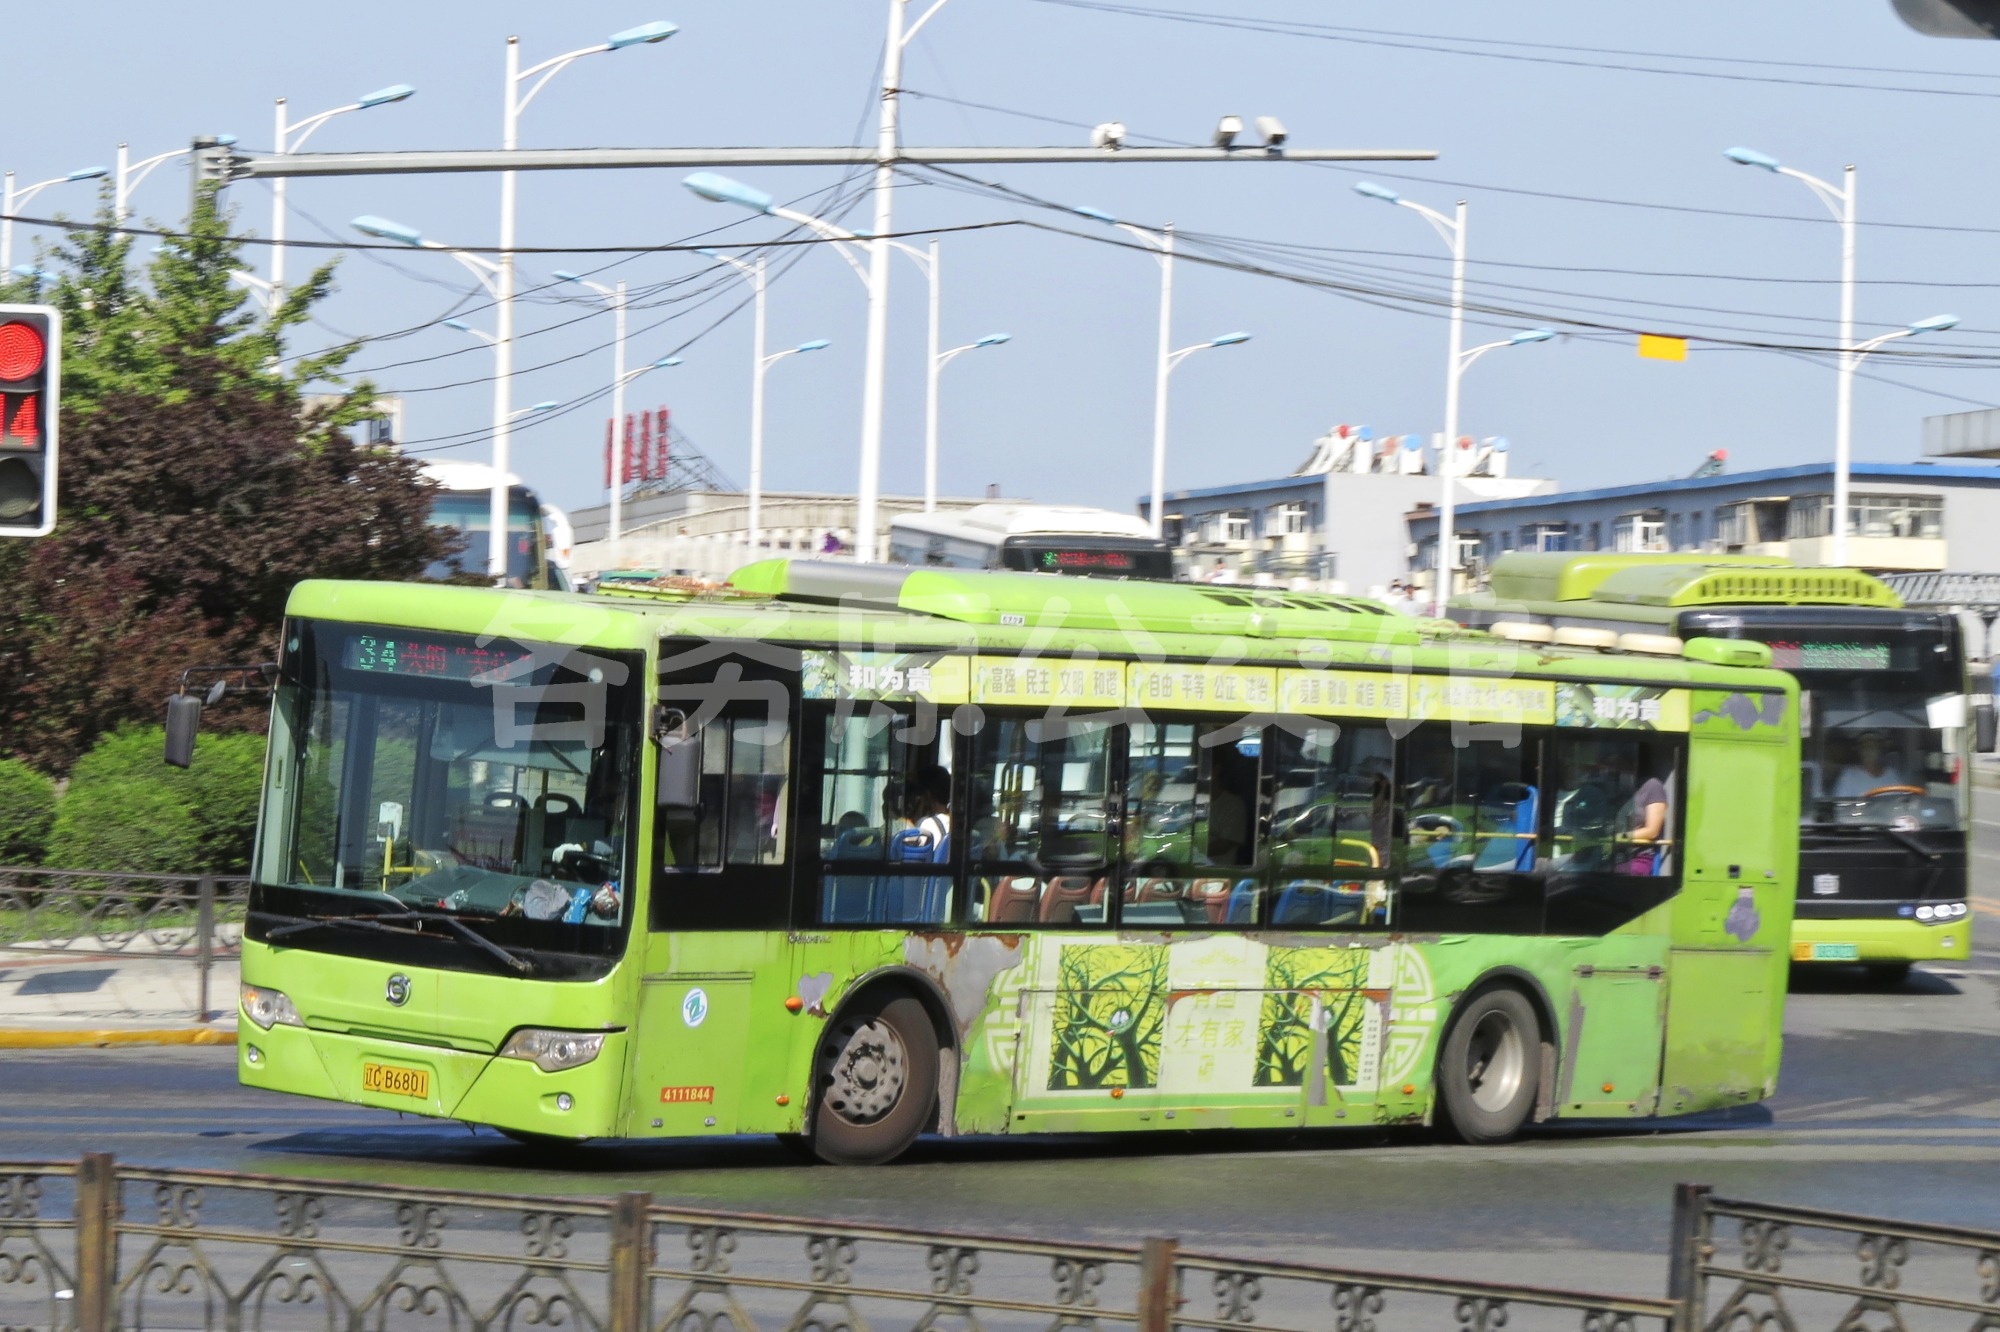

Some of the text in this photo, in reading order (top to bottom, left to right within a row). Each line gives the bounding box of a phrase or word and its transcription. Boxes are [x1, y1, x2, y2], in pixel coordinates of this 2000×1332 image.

[850, 664, 931, 692] 和为贵
[991, 666, 1118, 696] 富强 民主 文明 和谐
[1149, 672, 1173, 698] 自由
[1182, 673, 1205, 699] 平等
[1214, 674, 1237, 700] 公正
[1593, 696, 1660, 721] 和为贵
[1174, 1018, 1247, 1049] 才有家
[664, 1087, 710, 1101] 4111844
